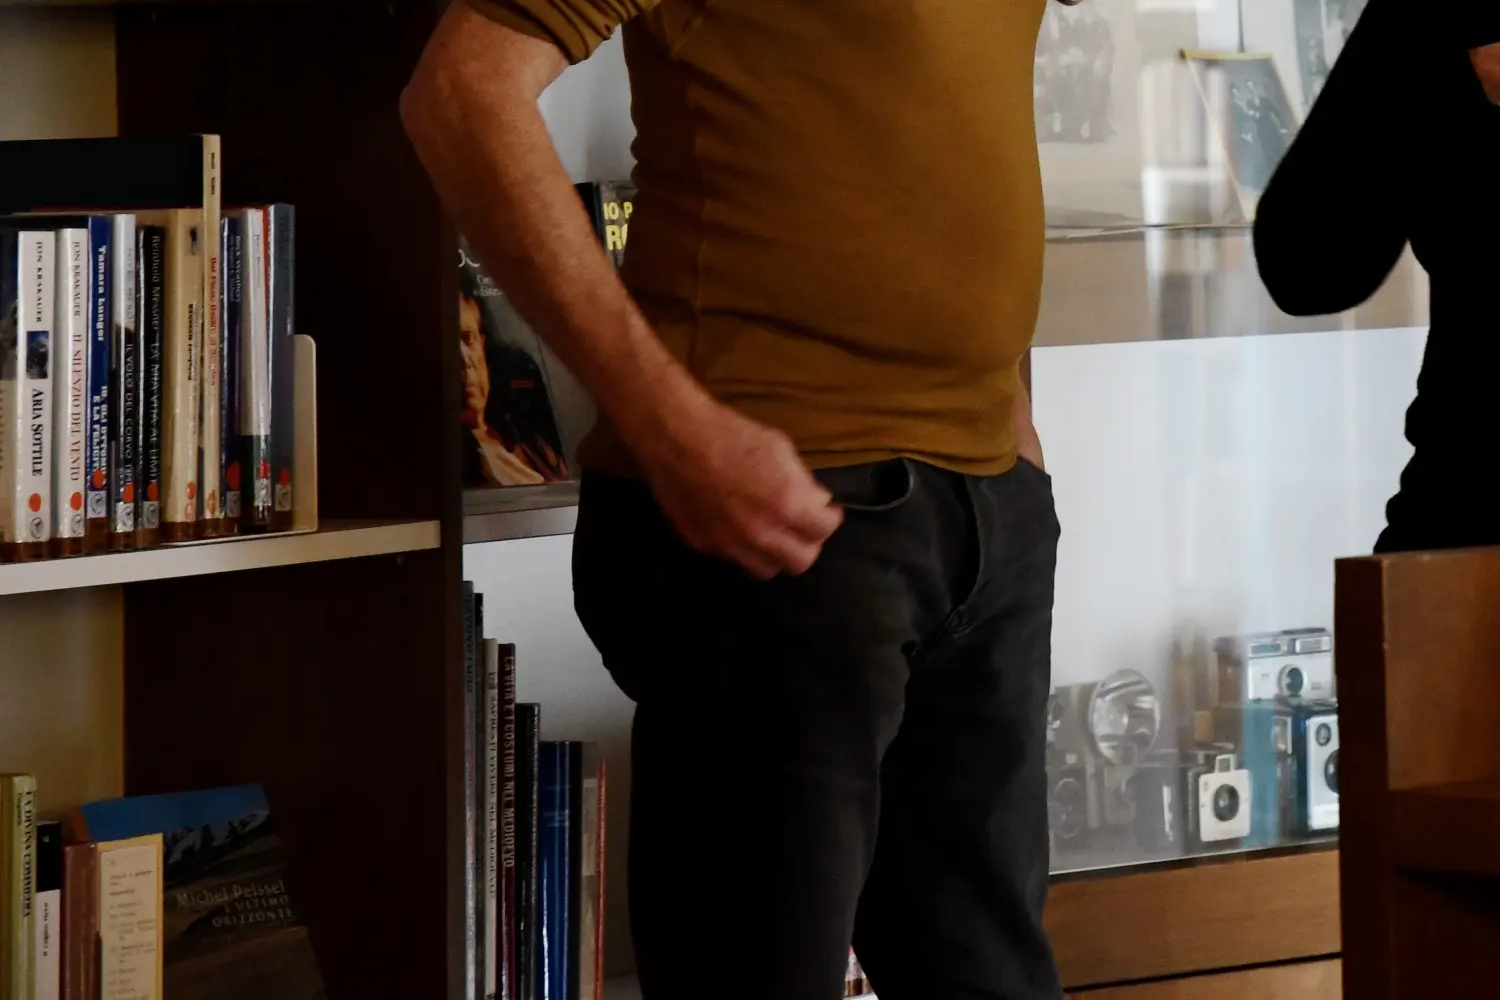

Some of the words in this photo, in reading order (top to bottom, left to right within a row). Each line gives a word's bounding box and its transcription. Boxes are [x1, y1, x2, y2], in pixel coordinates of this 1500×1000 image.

[36, 241, 44, 262] JON
[73, 241, 81, 261] JON
[151, 236, 161, 283] Reinhold
[97, 245, 107, 293] Tamara
[36, 267, 44, 322] KRAKAUER
[73, 265, 81, 316] KRAKAUER
[97, 298, 107, 341] Lunger
[152, 286, 161, 330] Messner
[72, 334, 82, 346] IL
[125, 344, 133, 353] IL
[72, 350, 82, 408] SILENZIO
[125, 357, 134, 388] VOLO
[150, 364, 159, 390] MIA
[32, 388, 43, 420] ARIA
[93, 409, 100, 421] LA
[100, 405, 108, 422] GLI
[125, 393, 133, 413] DEL
[71, 412, 82, 435] DEL
[32, 424, 44, 476] SOTTILE
[124, 419, 133, 459] CORVO
[71, 441, 81, 481] VENTO
[504, 656, 515, 671] LA
[504, 675, 516, 700] VITA
[503, 724, 515, 777] COSTUMI
[503, 782, 514, 803] NEL
[503, 808, 514, 868] MEDIOEVO
[176, 887, 229, 907] Michel
[212, 908, 293, 927] ORIZZONTE
